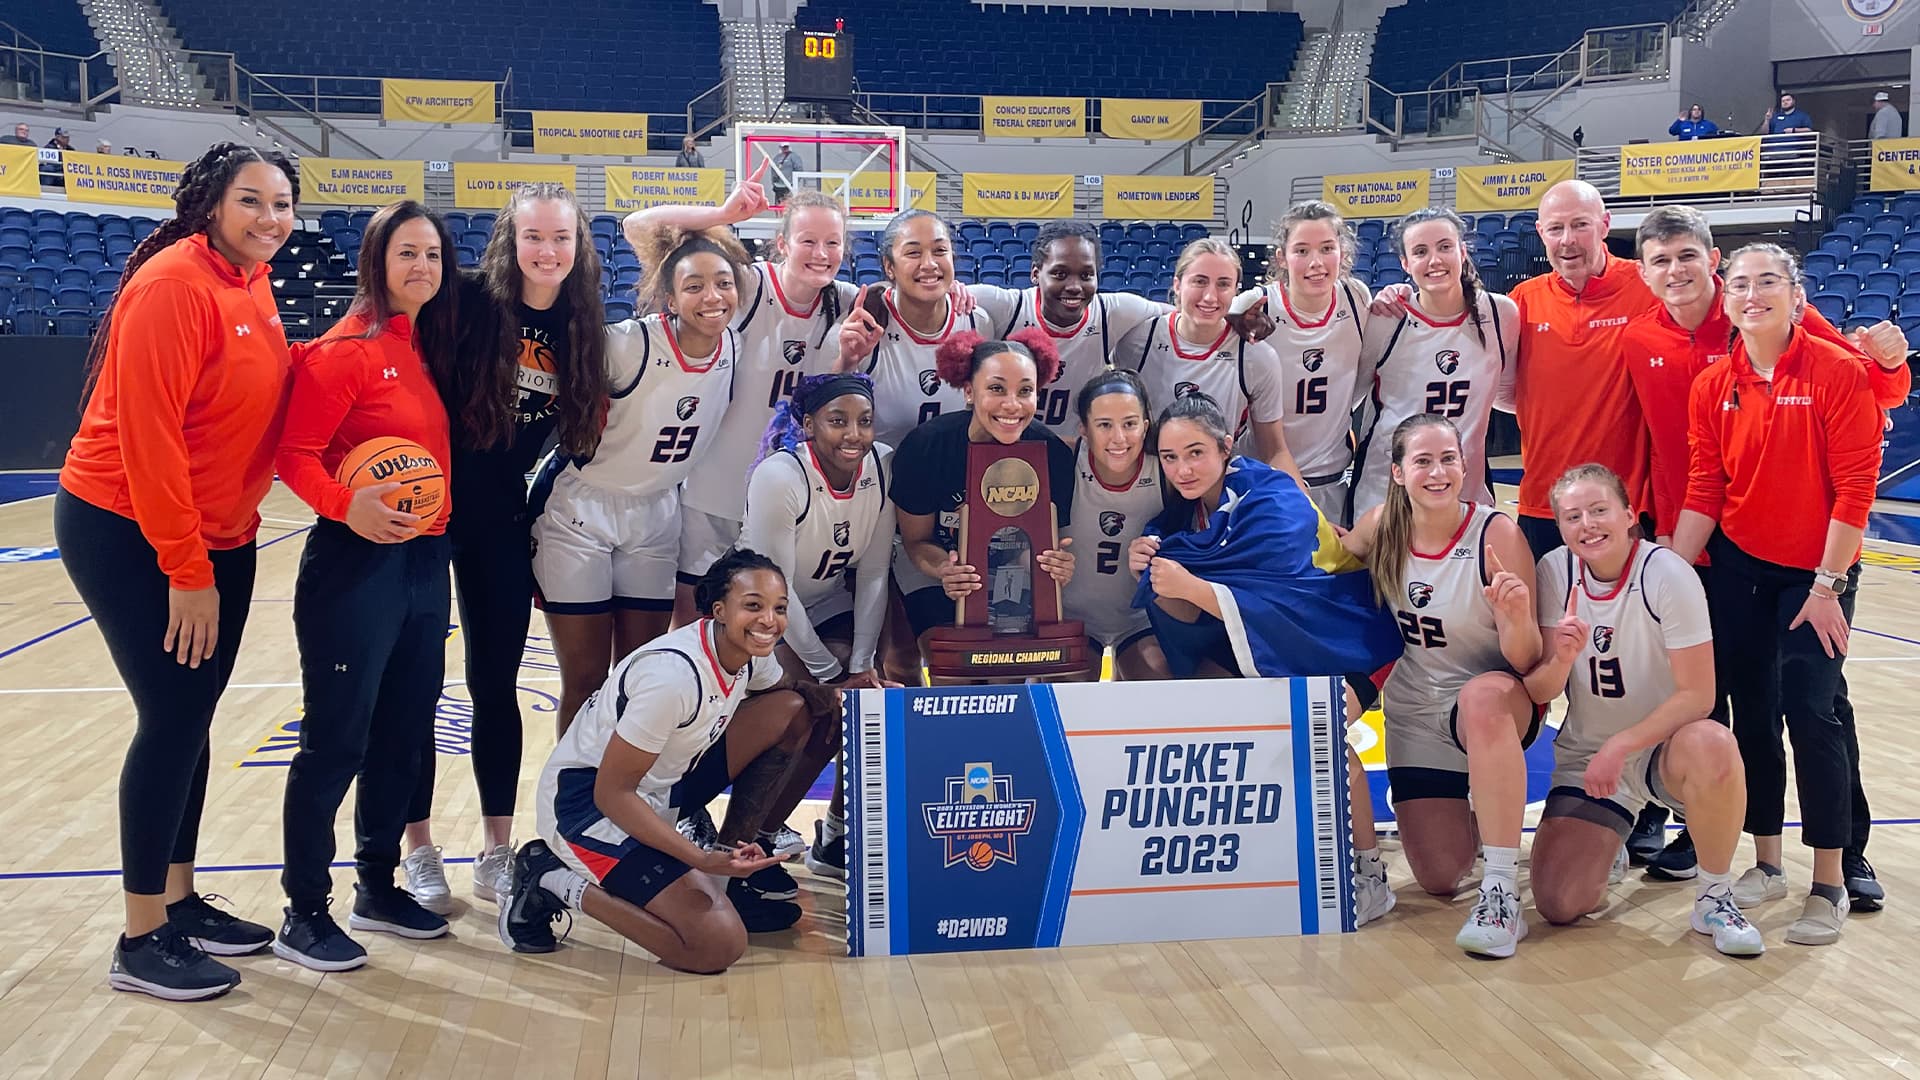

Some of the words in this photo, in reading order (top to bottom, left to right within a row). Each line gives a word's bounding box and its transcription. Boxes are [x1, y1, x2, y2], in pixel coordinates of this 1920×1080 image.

[805, 37, 835, 58] 0.0
[425, 97, 473, 106] ARCHITECTS
[996, 106, 1026, 114] CONCHO
[1028, 106, 1071, 115] EDUCATORS
[993, 118, 1024, 127] FEDERAL
[1027, 119, 1052, 128] CREDIT
[1054, 119, 1076, 128] UNION
[1131, 115, 1155, 124] GANDY
[1157, 115, 1169, 124] INK
[538, 128, 577, 138] TROPICAL
[579, 129, 620, 138] SMOOTHIE
[40, 151, 56, 160] 106
[1626, 156, 1662, 168] FOSTER
[1665, 149, 1754, 166] COMMUNICATIONS
[67, 163, 92, 175] CECIL
[96, 166, 104, 176] A.
[107, 167, 130, 178] ROSS
[331, 169, 349, 178] EJM
[351, 170, 393, 180] RANCHES
[1438, 168, 1452, 177] 109
[1908, 164, 1915, 174] &
[632, 171, 665, 180] ROBERT
[668, 172, 698, 181] MASSIE
[1482, 175, 1508, 186] JIMMY
[1510, 174, 1517, 184] &
[1519, 172, 1547, 183] CAROL
[76, 178, 94, 188] AND
[98, 180, 148, 193] INSURANCE
[318, 183, 337, 193] ELTA
[341, 184, 368, 194] JOYCE
[371, 185, 407, 195] MCAFEE
[467, 179, 495, 190] LLOYD
[497, 180, 503, 190] &
[633, 186, 670, 195] FUNERAL
[673, 186, 697, 196] HOME
[1334, 184, 1356, 193] FIRST
[1357, 182, 1394, 193] NATIONAL
[1396, 180, 1417, 190] BANK
[865, 188, 870, 197] &
[977, 190, 1011, 200] RICHARD
[1014, 191, 1019, 200] &
[1021, 191, 1031, 200] BJ
[1033, 191, 1060, 200] MAYER
[1117, 191, 1163, 201] HOMETOWN
[1165, 191, 1200, 201] LENDERS
[1497, 186, 1531, 197] BARTON
[615, 199, 640, 209] RUSTY
[644, 200, 649, 208] &
[1348, 195, 1358, 205] OF
[1360, 194, 1402, 204] ELDORADO
[1296, 376, 1328, 414] 15
[1425, 380, 1470, 417] 25
[650, 426, 700, 463] 23
[368, 454, 437, 480] Wilson
[987, 485, 1037, 503] NCAA
[1096, 542, 1121, 575] 2
[811, 550, 854, 581] 12
[1397, 610, 1448, 649] 22
[971, 653, 1014, 664] REGIONAL
[1015, 650, 1061, 663] CHAMPION
[1589, 656, 1625, 699] 13
[913, 694, 1018, 716] #ELITEEIGHT
[1124, 741, 1255, 786] TICKET
[969, 777, 990, 785] NCAA
[993, 803, 1022, 811] WOMEN'S
[1101, 783, 1282, 830] PUNCHED
[936, 811, 978, 829] ELITE
[980, 809, 1025, 827] EIGHT
[1140, 833, 1240, 876] 2023
[937, 916, 1008, 938] #D2WBB
